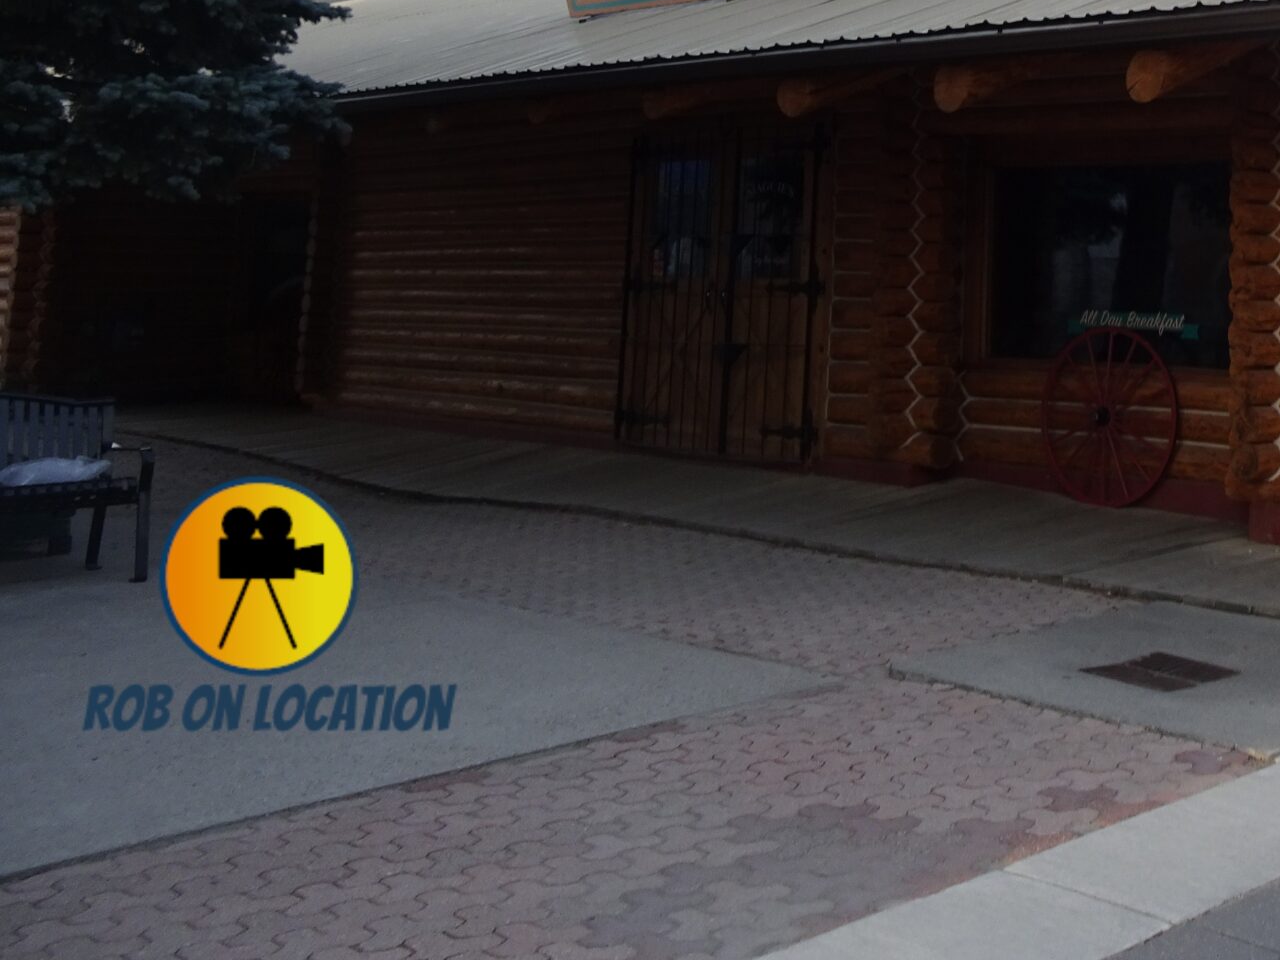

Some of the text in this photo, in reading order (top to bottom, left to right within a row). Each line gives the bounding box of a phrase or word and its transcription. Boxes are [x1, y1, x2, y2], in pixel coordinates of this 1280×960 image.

[1080, 310, 1185, 337] All Day Breakfast
